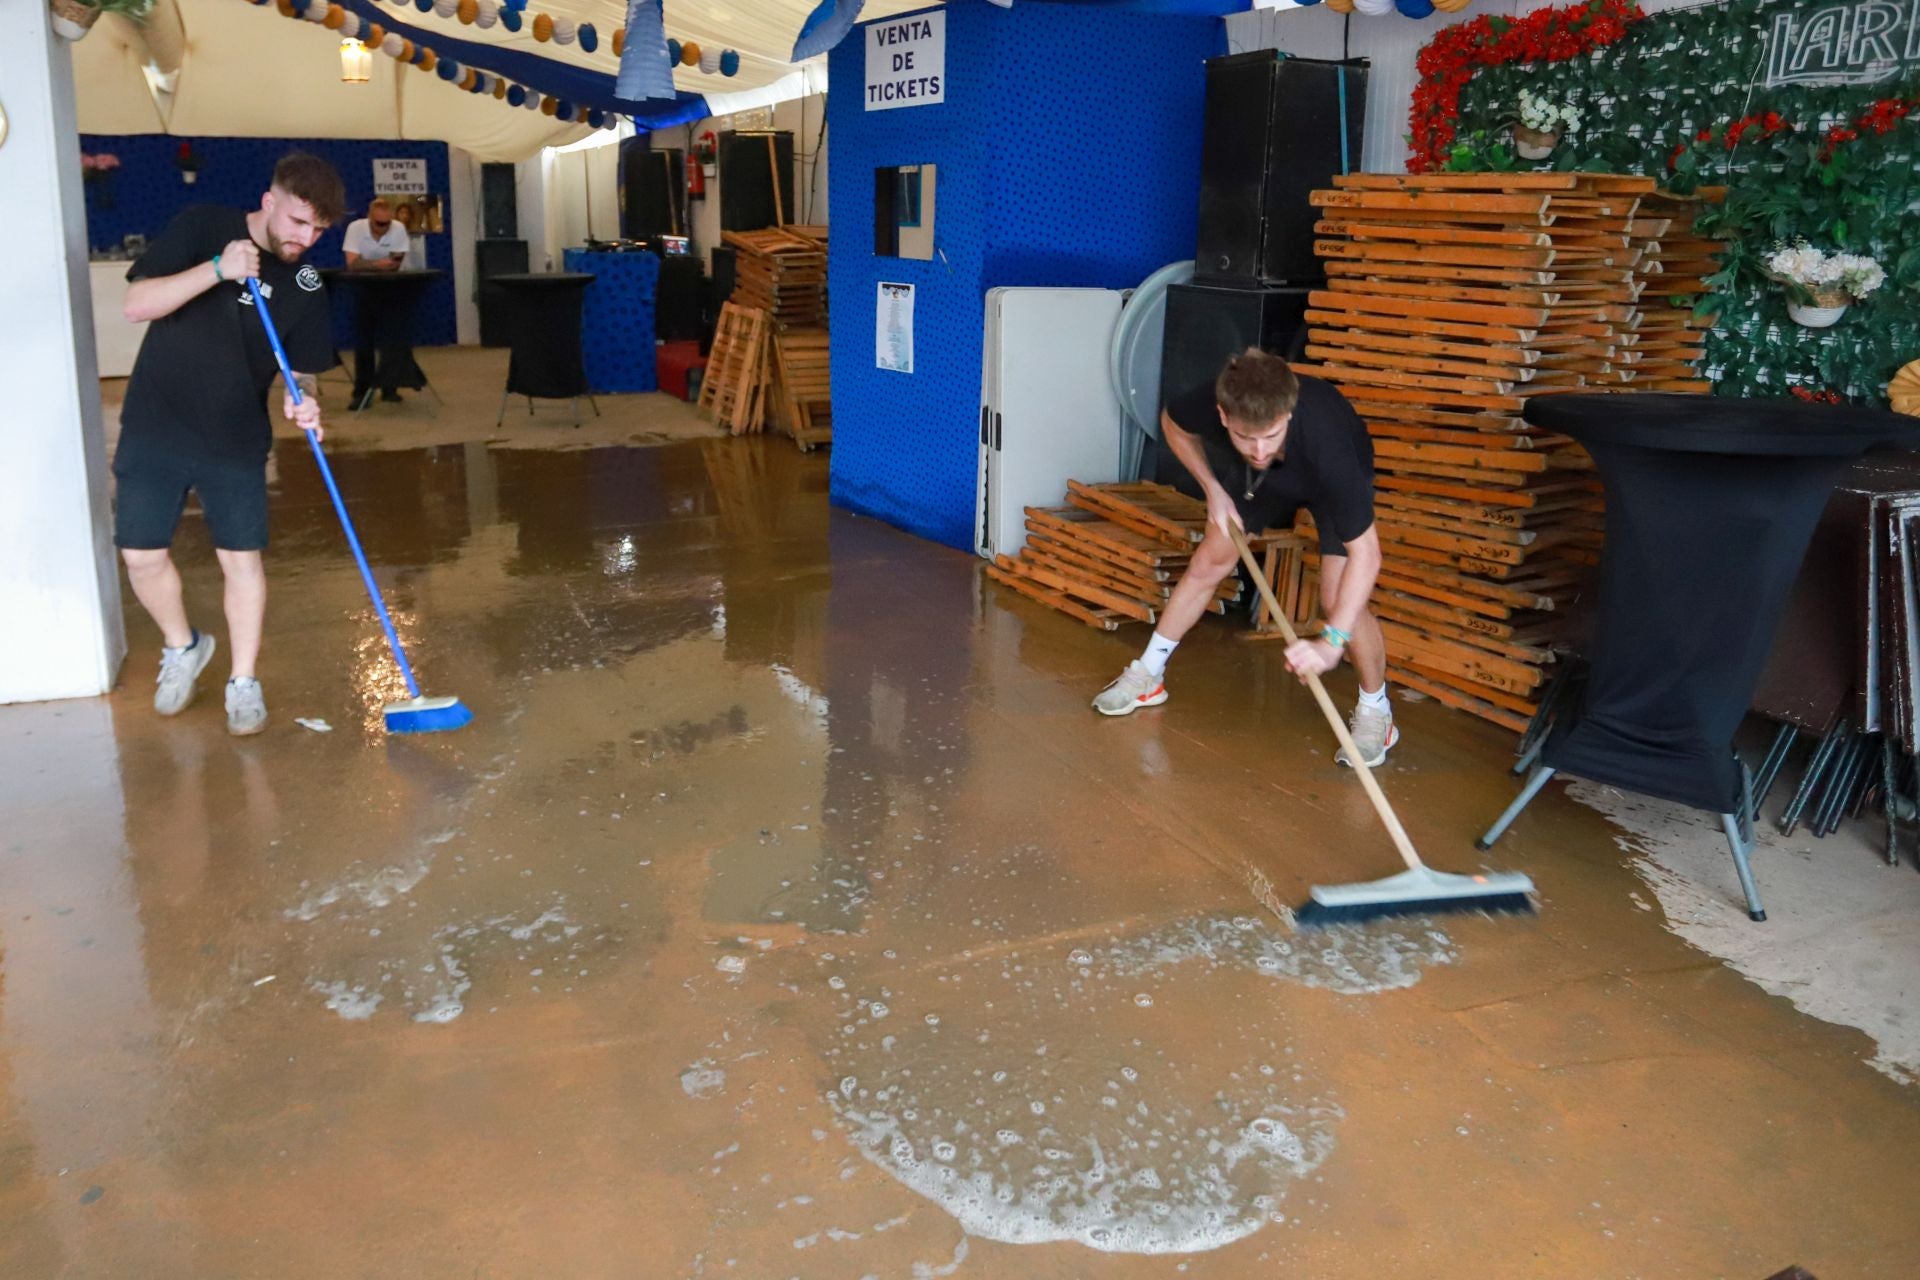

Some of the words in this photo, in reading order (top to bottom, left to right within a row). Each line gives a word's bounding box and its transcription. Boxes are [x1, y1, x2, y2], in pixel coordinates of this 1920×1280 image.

[876, 19, 932, 47] VENTA
[892, 51, 914, 72] DE
[867, 76, 940, 103] TICKETS
[380, 161, 418, 170] VENTA
[392, 172, 407, 181] DE
[376, 183, 425, 192] TICKETS
